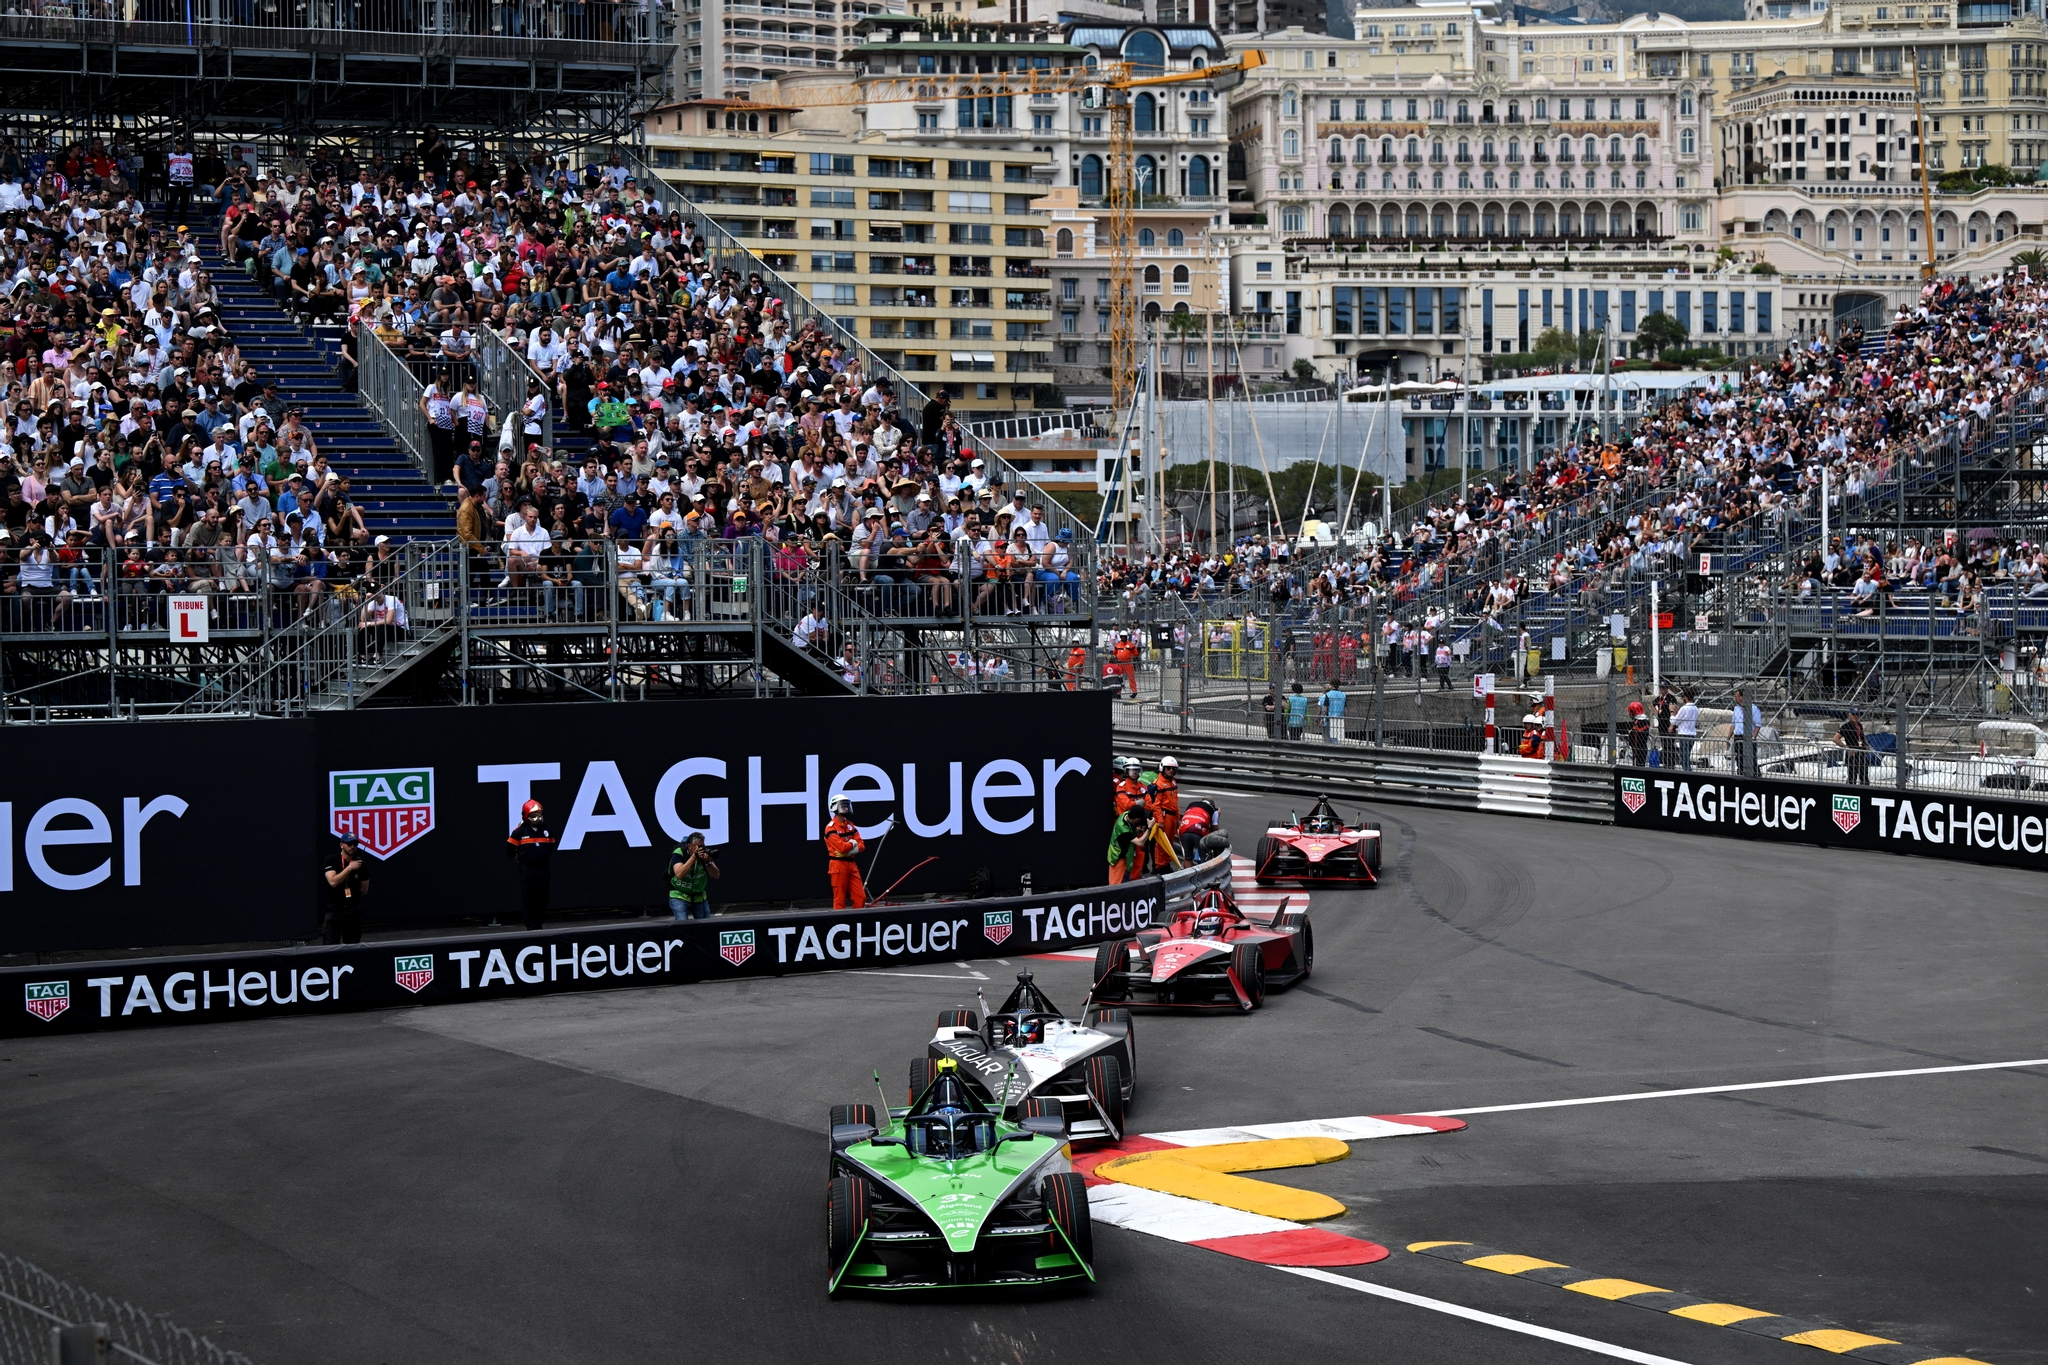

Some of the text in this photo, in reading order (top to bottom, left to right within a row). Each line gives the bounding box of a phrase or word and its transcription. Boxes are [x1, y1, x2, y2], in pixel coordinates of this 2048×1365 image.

[173, 601, 204, 610] TRIBUNE
[181, 612, 198, 637] L
[340, 775, 423, 803] TAG
[1623, 780, 1644, 791] TAG
[1835, 797, 1858, 811] TAG
[1834, 811, 1859, 831] HEUER
[338, 809, 427, 851] HEUER
[986, 913, 1010, 924] TAG
[723, 933, 752, 944] TAG
[986, 925, 1011, 943] HEUER
[722, 945, 753, 963] HEUER
[398, 958, 430, 970] TAG
[398, 971, 431, 990] HEUER
[29, 984, 65, 998] TAG
[29, 999, 67, 1018] HEUER
[938, 1041, 1004, 1077] JAGUAR
[941, 1193, 975, 1203] 37
[945, 1222, 975, 1230] ABB
